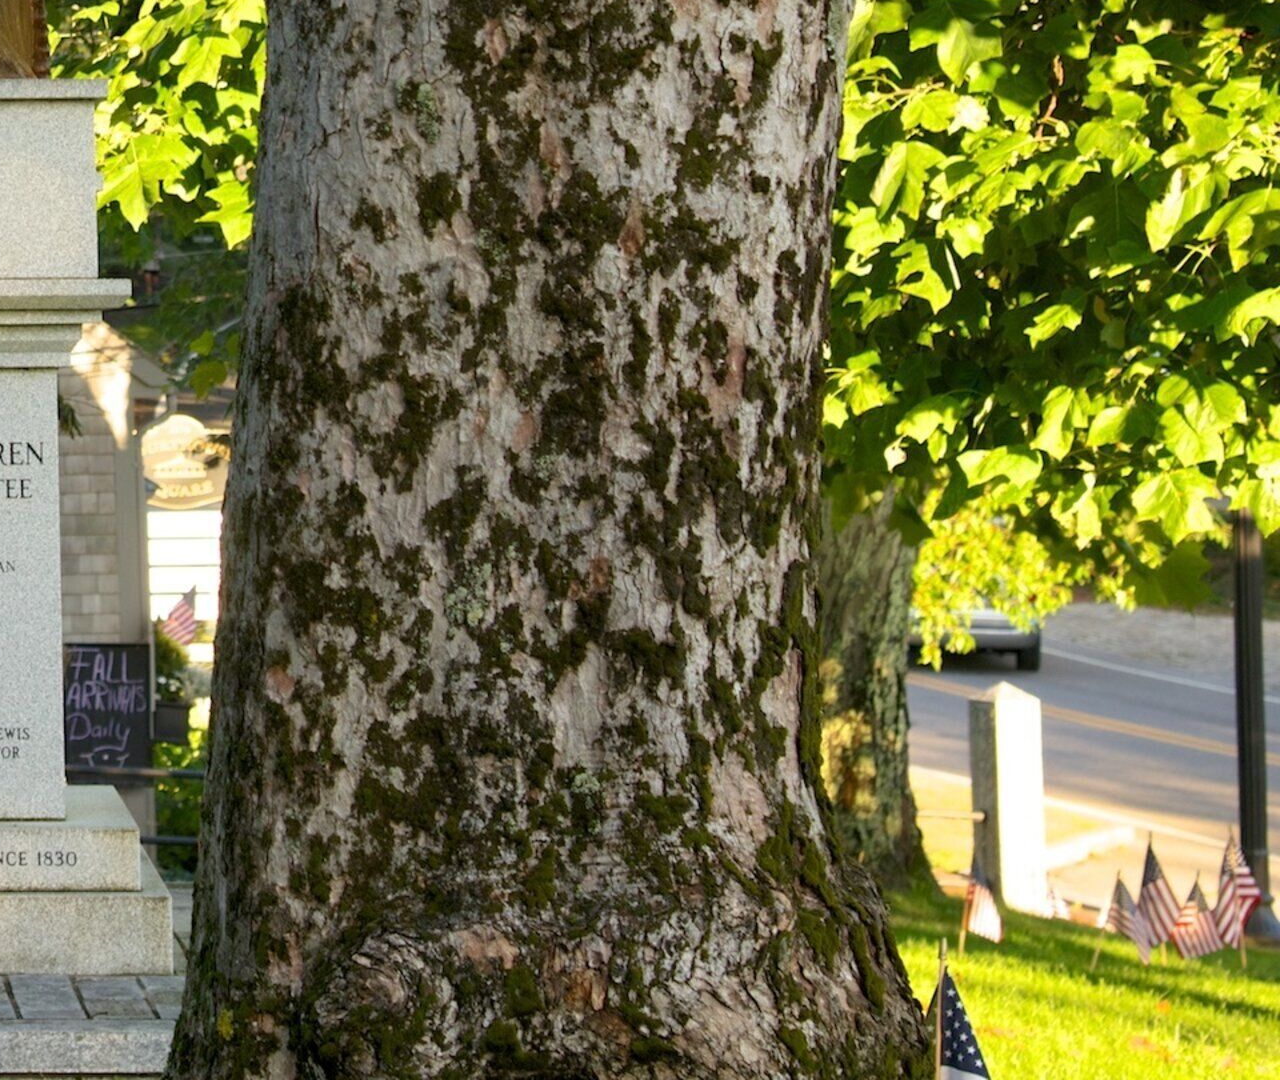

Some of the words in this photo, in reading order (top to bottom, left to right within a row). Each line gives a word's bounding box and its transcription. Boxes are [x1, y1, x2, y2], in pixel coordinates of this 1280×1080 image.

[68, 647, 146, 684] FALL
[65, 711, 131, 752] Daily
[36, 851, 78, 867] 1830
